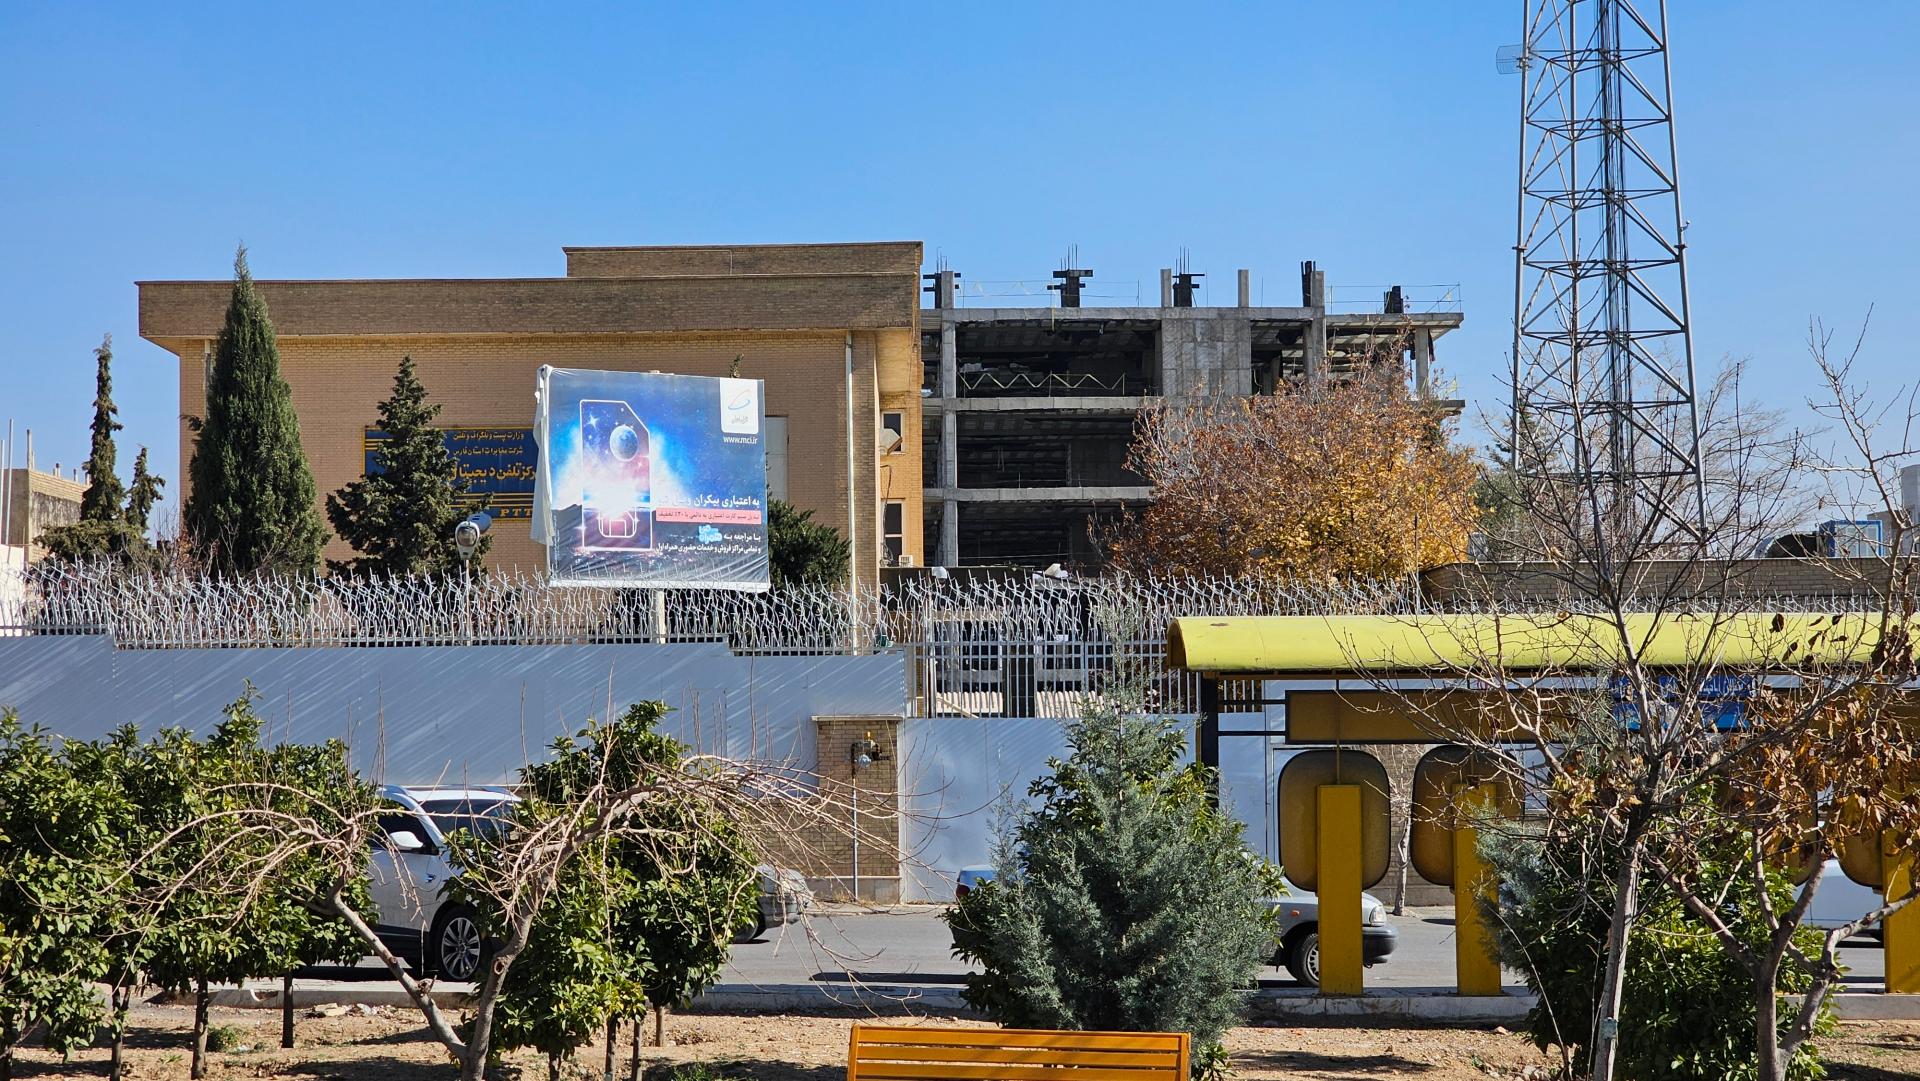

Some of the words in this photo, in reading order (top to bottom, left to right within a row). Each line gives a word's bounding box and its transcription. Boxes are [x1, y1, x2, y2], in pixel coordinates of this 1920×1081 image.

[453, 430, 466, 440] تلفن
[471, 430, 489, 440] تلگراف
[493, 431, 507, 441] پست
[507, 432, 524, 440] وزارت
[723, 434, 758, 445] www.mci.ir
[453, 446, 467, 456] فارس
[468, 445, 484, 455] استان
[484, 446, 507, 456] مخابرات
[508, 445, 523, 455] شرکت
[496, 462, 522, 480] تلفن
[519, 464, 537, 480] رکز
[693, 493, 720, 507] بیکران
[721, 493, 752, 508] اعتباری
[752, 498, 760, 509] به
[723, 533, 733, 542] به
[733, 532, 753, 543] مراجعه
[753, 532, 761, 543] با
[656, 542, 664, 552] اول
[664, 543, 678, 552] همراه
[678, 543, 697, 553] حضوری
[696, 543, 714, 551] خدمات
[717, 543, 732, 553] فروش
[731, 544, 744, 554] مراکز
[743, 545, 758, 554] تمامی
